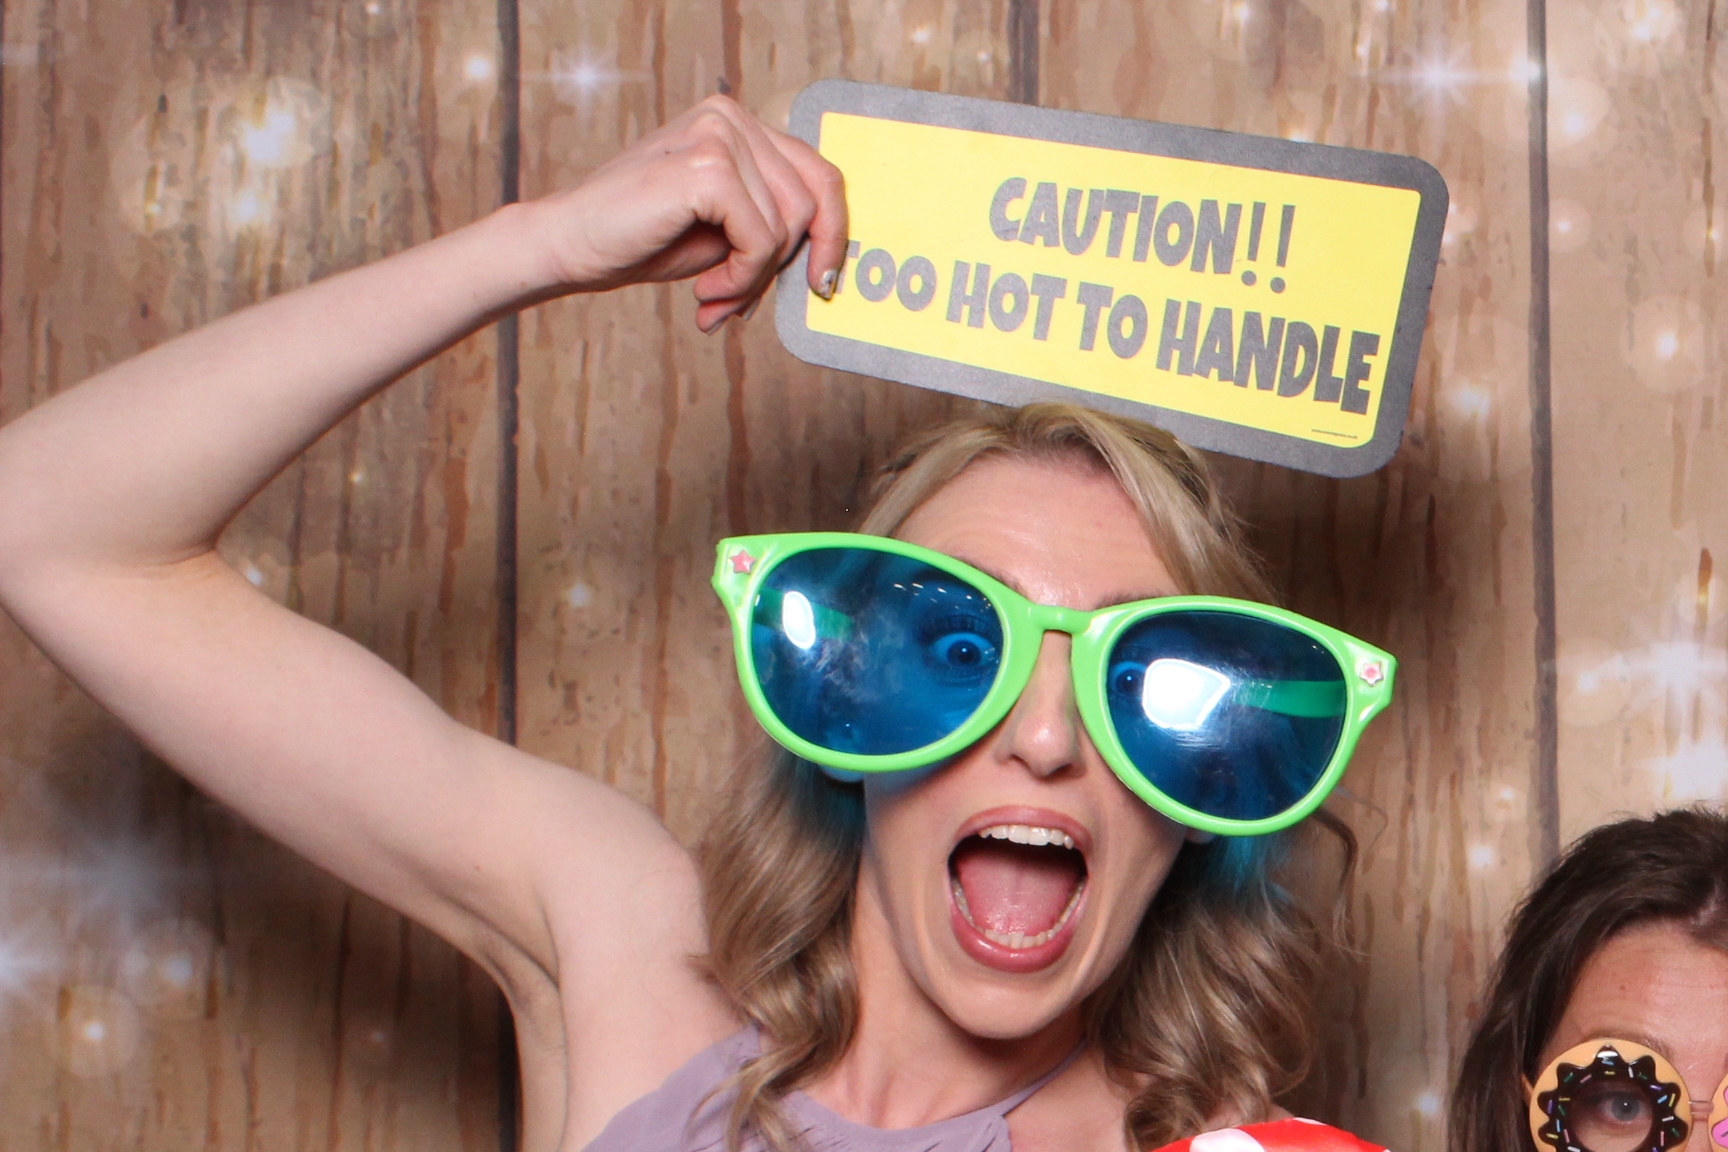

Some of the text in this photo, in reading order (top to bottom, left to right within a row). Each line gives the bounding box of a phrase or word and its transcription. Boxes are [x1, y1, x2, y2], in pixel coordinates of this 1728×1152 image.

[989, 176, 1296, 294] CAUTION!!
[945, 259, 1068, 342] HOT
[1076, 281, 1149, 360] TO
[1156, 298, 1381, 415] HANDLE
